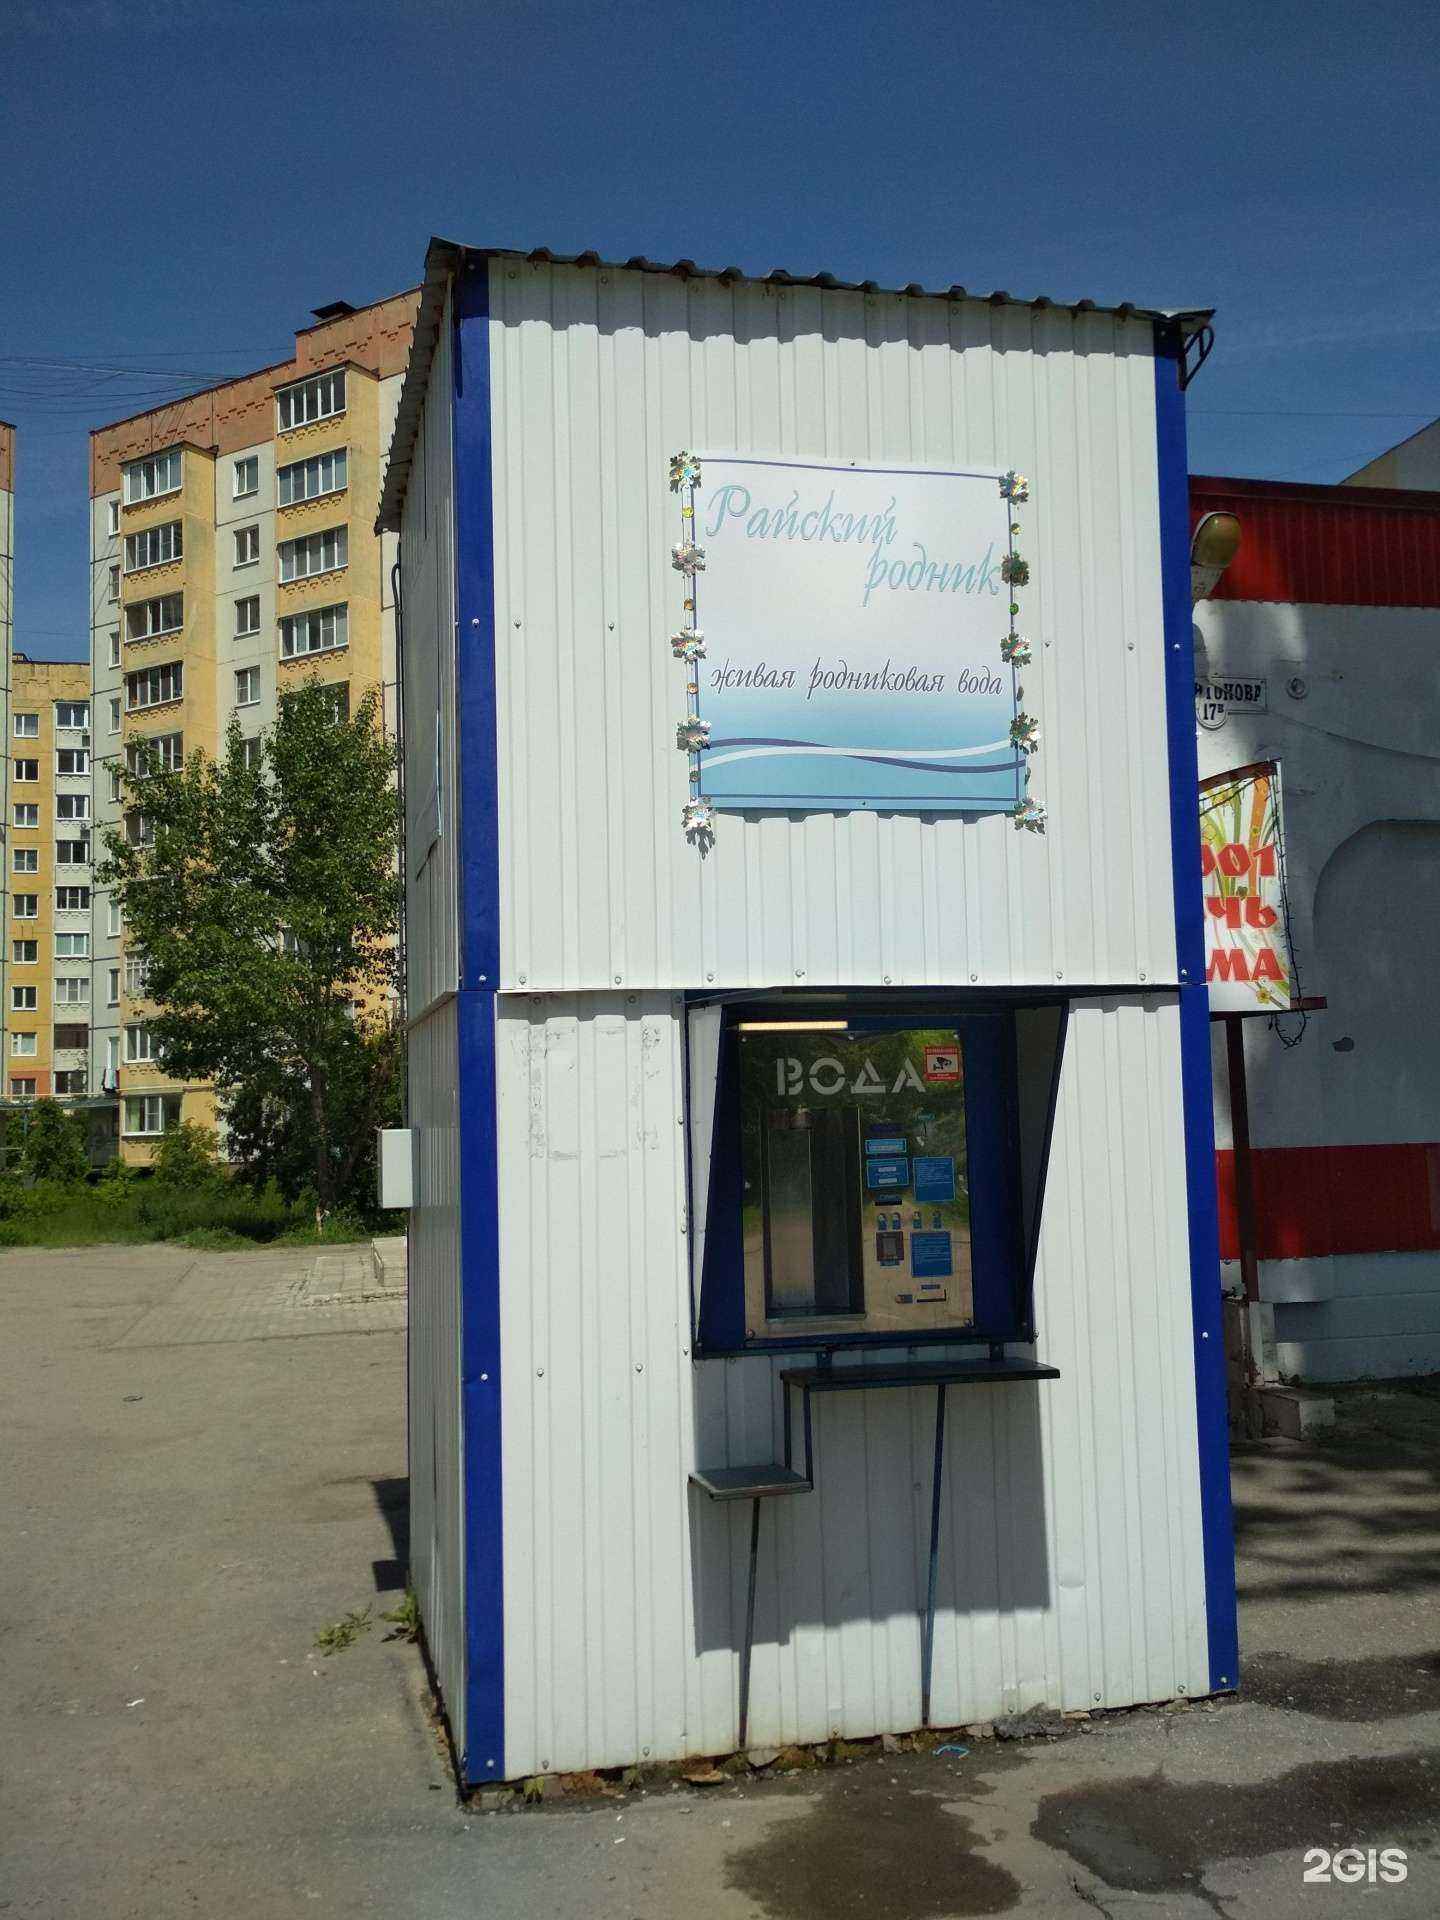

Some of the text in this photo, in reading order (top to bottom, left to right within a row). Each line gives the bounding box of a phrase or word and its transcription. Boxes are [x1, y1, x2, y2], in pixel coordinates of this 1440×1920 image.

[705, 484, 898, 544] Райский
[862, 541, 1001, 607] родник
[711, 657, 1002, 700] живая родниковая вода
[1206, 896, 1278, 928] ЧЬ
[1206, 948, 1285, 981] МА
[776, 1056, 926, 1096] ВОДА
